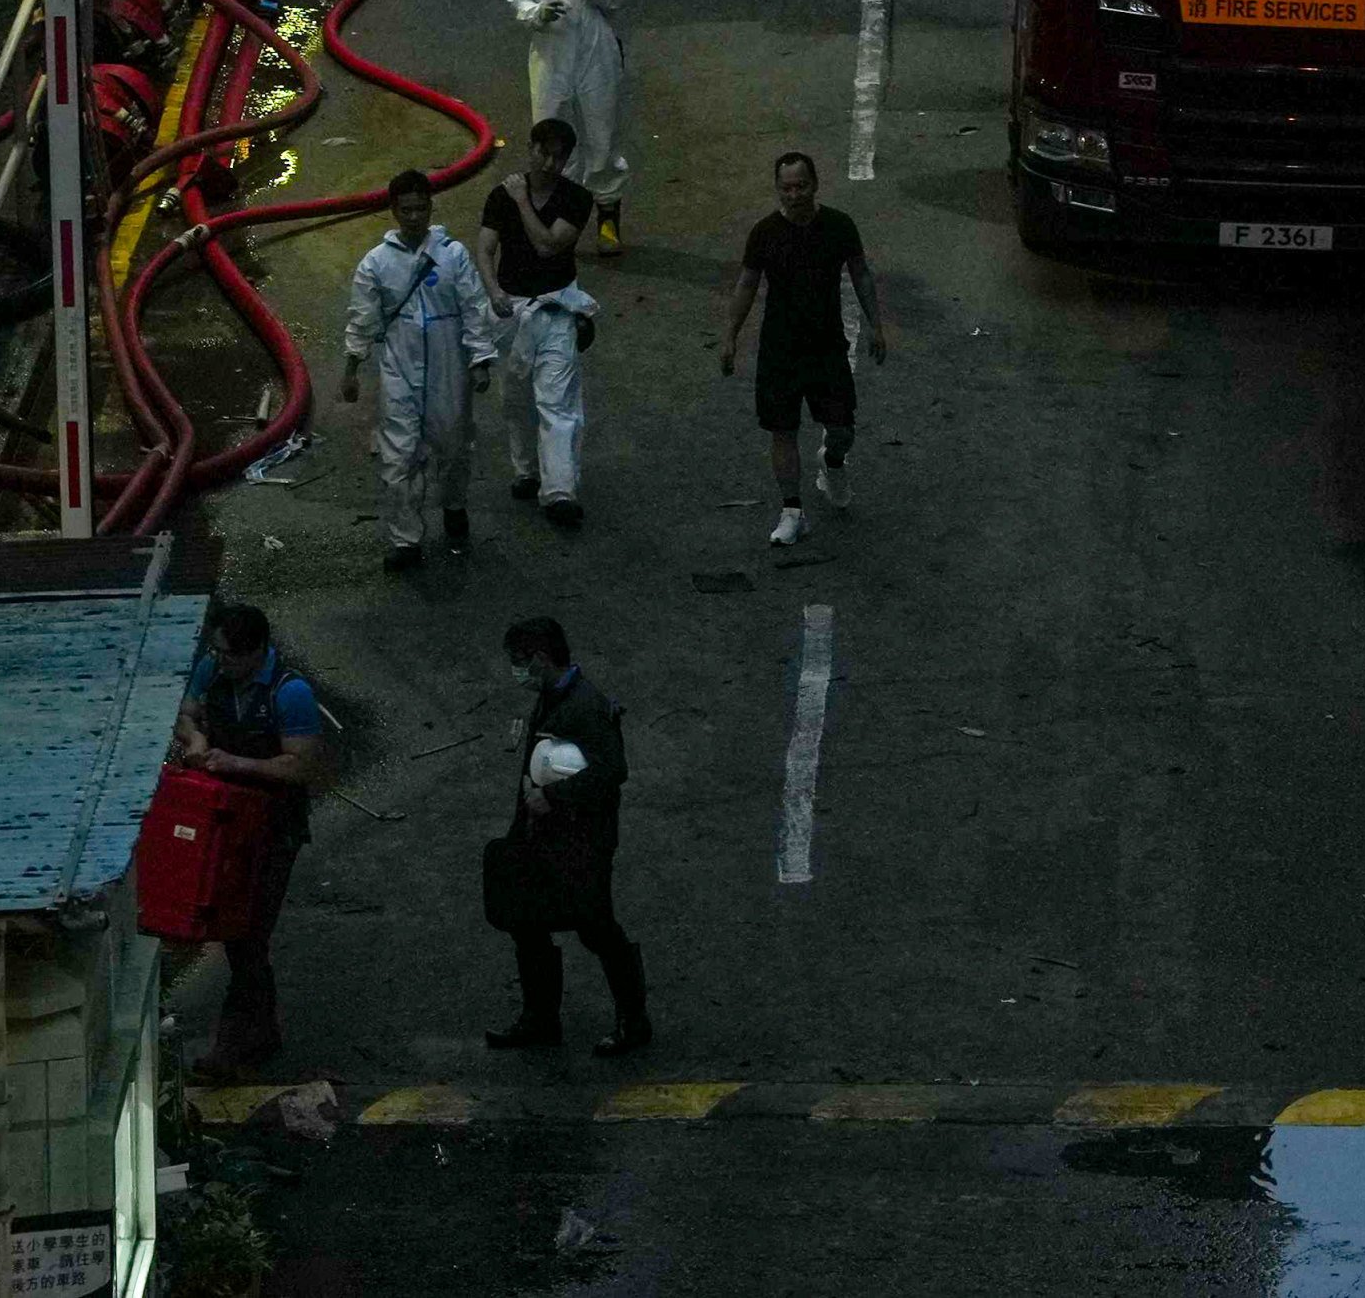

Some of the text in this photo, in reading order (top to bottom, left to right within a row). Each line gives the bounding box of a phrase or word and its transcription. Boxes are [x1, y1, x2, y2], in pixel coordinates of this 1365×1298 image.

[1263, 0, 1357, 23] SERVICES
[1235, 227, 1318, 248] F 2361
